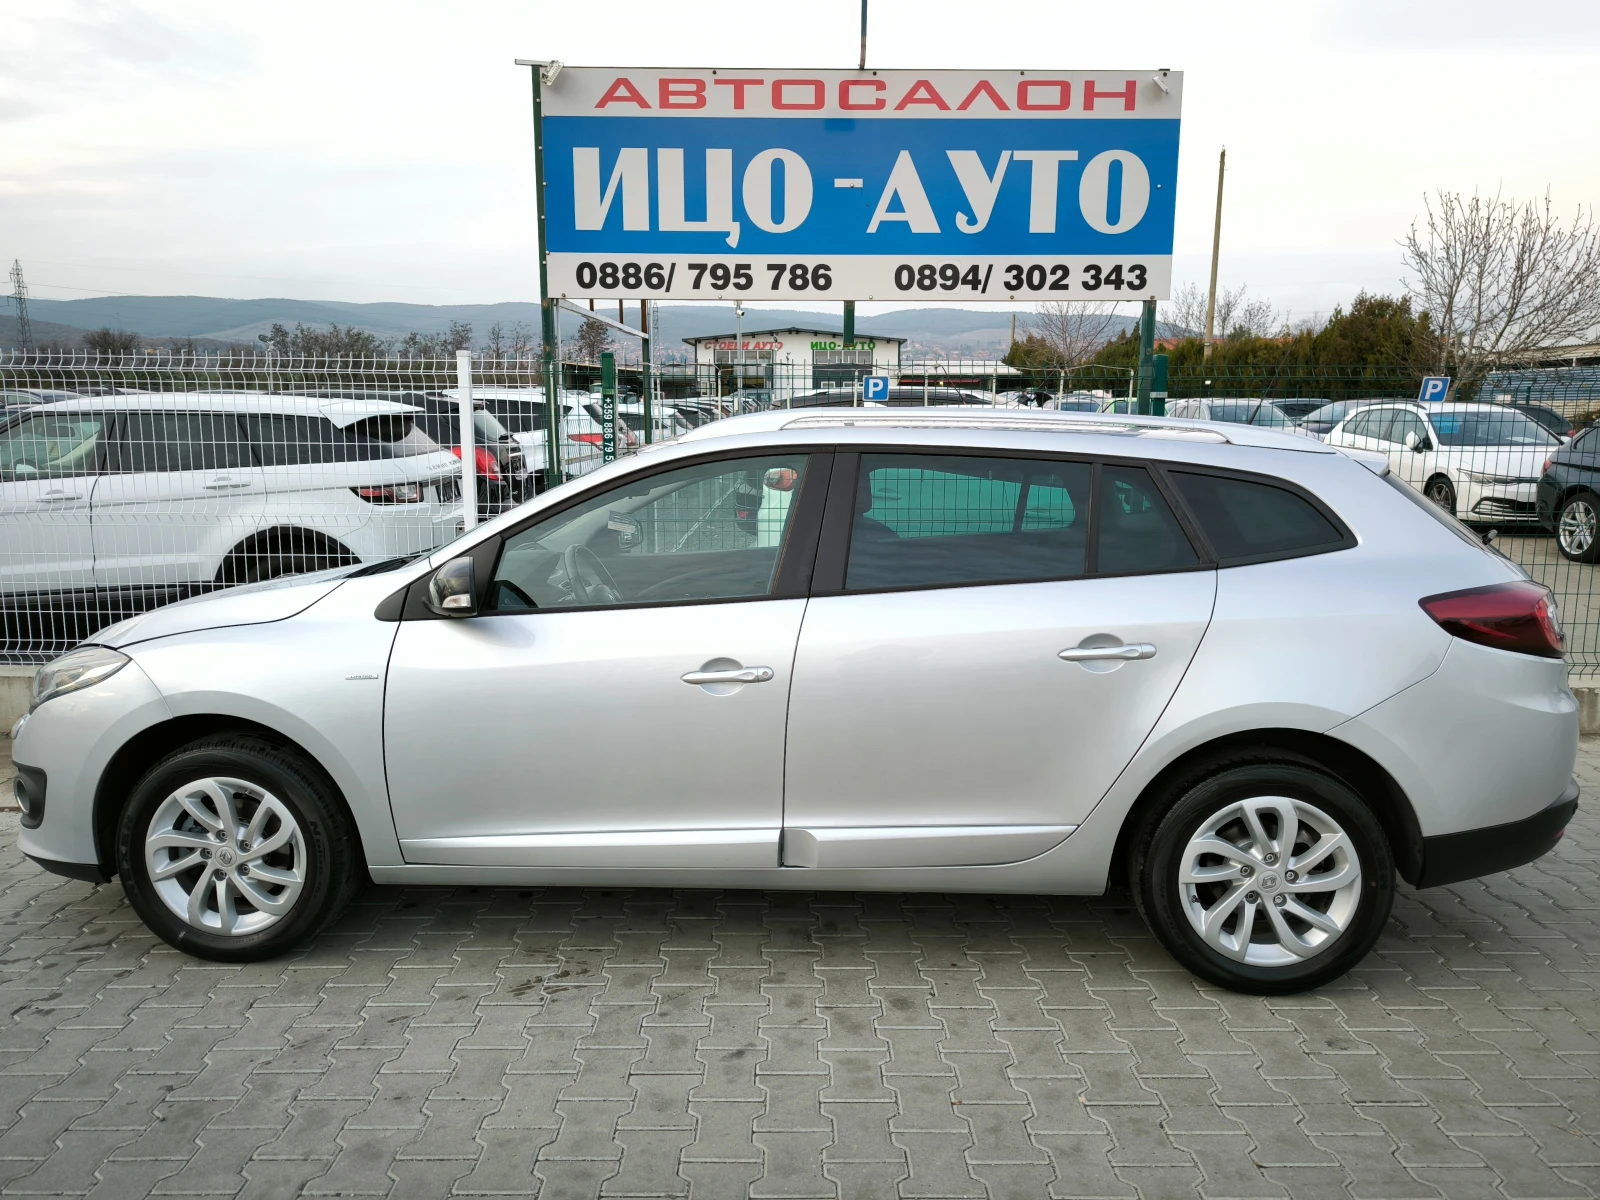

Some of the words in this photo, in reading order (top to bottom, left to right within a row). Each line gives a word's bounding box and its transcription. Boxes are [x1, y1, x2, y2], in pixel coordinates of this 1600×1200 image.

[594, 78, 1137, 112] АВТОСАЛОН
[576, 262, 677, 293] 0886/
[688, 263, 754, 291] 795
[767, 263, 833, 291] 786
[894, 264, 994, 294] 0894/
[1003, 264, 1070, 292] 302
[1081, 264, 1148, 291] 343
[703, 341, 750, 350] СТОЕИ
[868, 378, 884, 398] P
[1424, 380, 1443, 400] P
[603, 397, 613, 420] +359
[603, 422, 614, 439] 886
[604, 441, 614, 453] 79
[605, 455, 615, 464] 5
